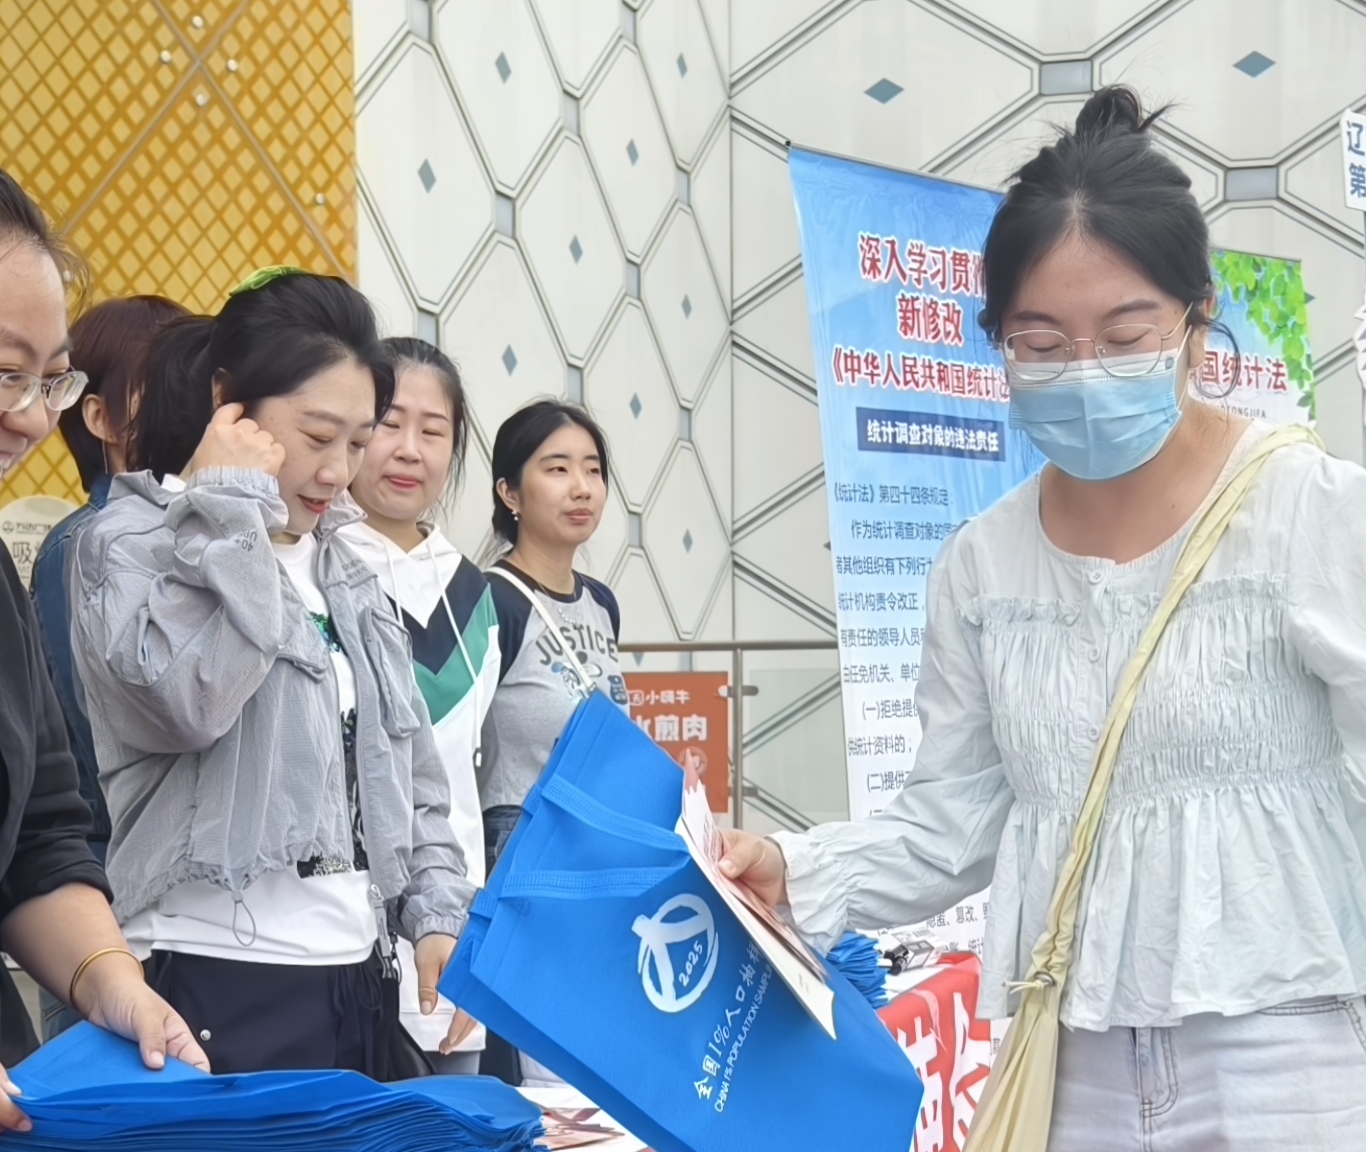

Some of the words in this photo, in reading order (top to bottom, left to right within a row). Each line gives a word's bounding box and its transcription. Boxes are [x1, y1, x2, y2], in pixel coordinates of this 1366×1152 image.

[897, 292, 965, 345] 新修改
[866, 418, 1000, 453] 统计调查对象的违法责任
[536, 620, 620, 667] JUSTICE
[679, 941, 703, 987] 2025
[727, 1000, 760, 1066] POPULATION
[723, 1066, 734, 1081] 1%
[714, 1081, 730, 1113] CHINA
